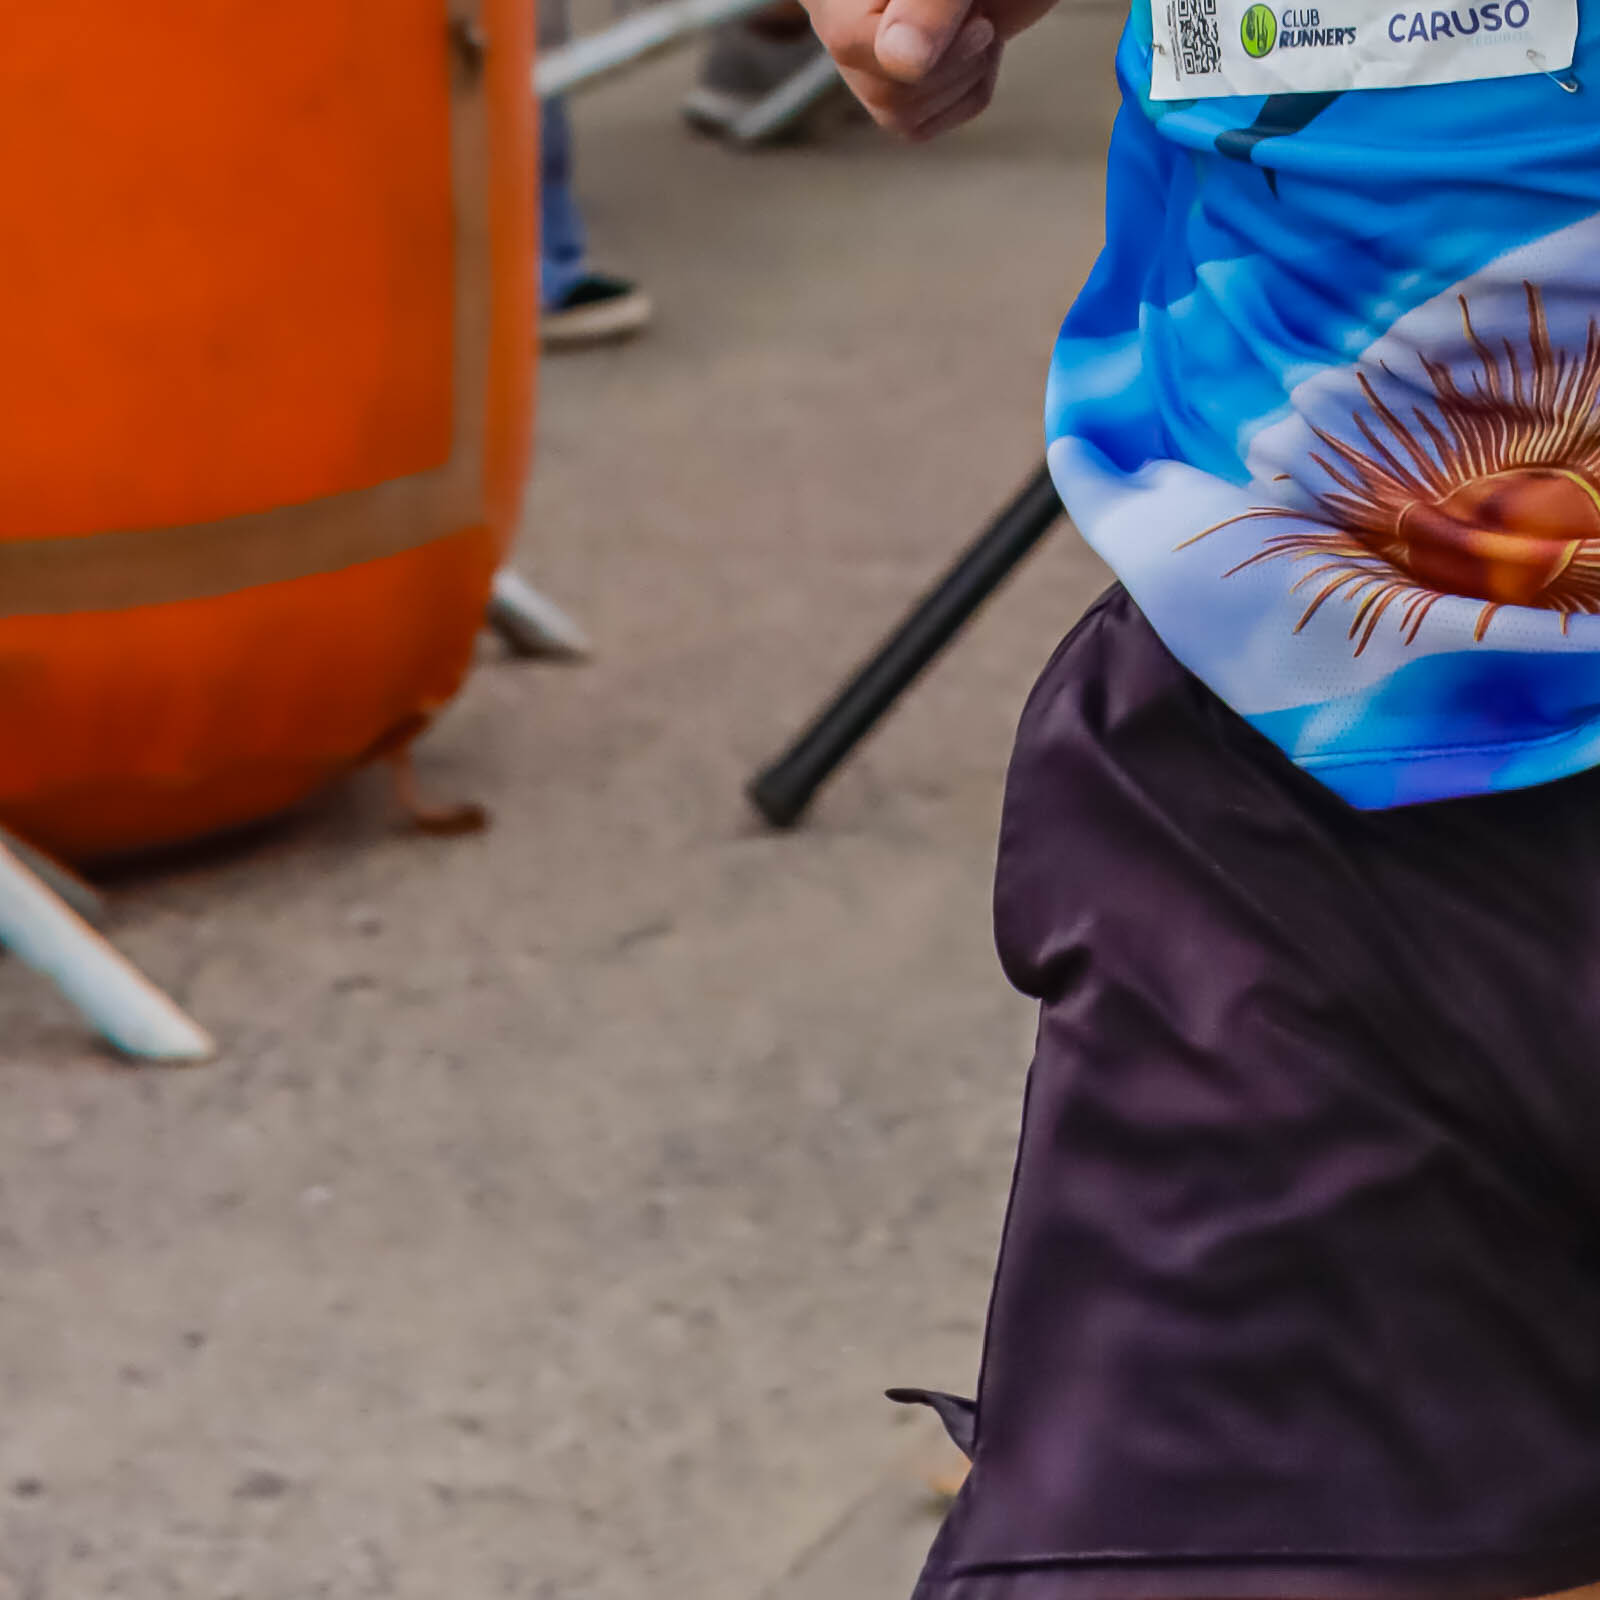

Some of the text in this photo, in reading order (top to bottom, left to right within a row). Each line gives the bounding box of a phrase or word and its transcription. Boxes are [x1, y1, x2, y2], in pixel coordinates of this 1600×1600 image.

[1282, 8, 1320, 28] CLUB
[1388, 0, 1531, 43] CARUSO
[1279, 26, 1357, 49] RUNNER'S
